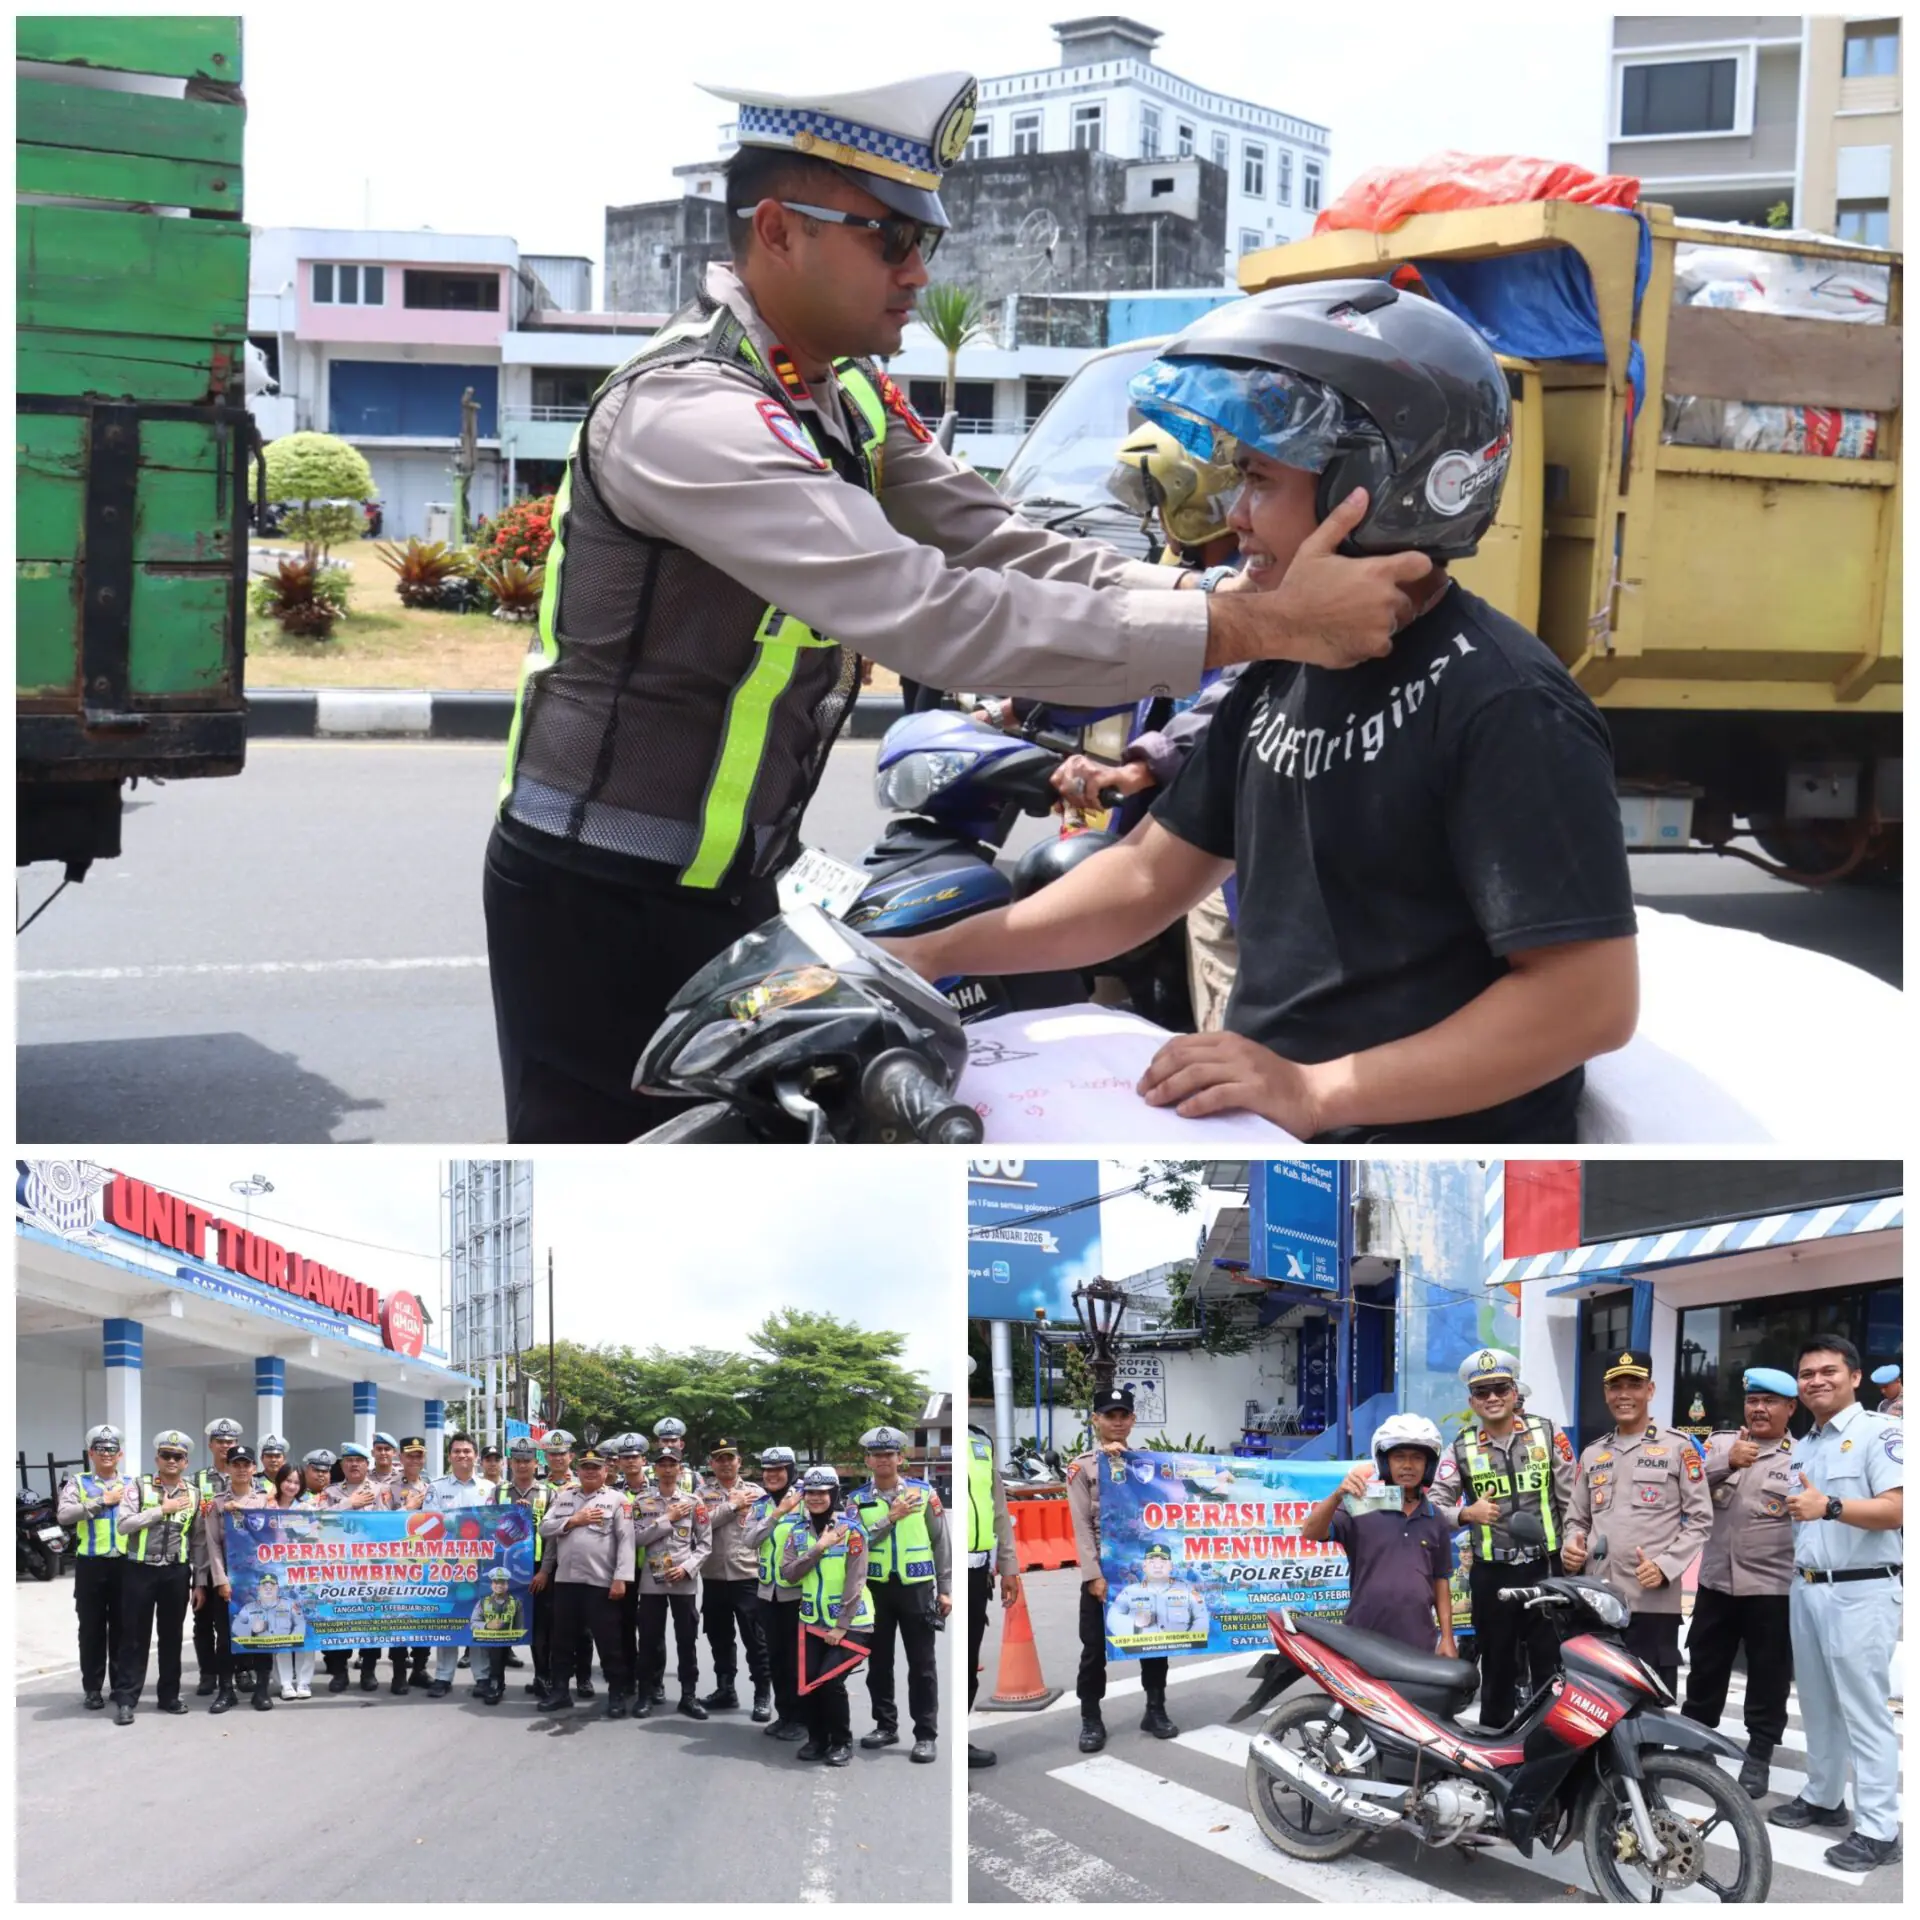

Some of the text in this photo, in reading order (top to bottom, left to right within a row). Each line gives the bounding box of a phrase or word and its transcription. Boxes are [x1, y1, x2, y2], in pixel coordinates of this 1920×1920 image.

[1311, 1163, 1332, 1179] Cepat
[1273, 1163, 1332, 1193] di Kab. Belitung
[983, 1199, 998, 1208] Fasa
[1000, 1202, 1023, 1210] semua
[991, 1230, 1023, 1240] JANUARI
[1023, 1232, 1044, 1243] 2026
[103, 1168, 381, 1326] UNIT TURJAWALI
[983, 1267, 990, 1276] di
[1315, 1273, 1335, 1284] more
[1118, 1367, 1160, 1376] KO-ZE
[1526, 1462, 1549, 1471] POLRI
[1637, 1458, 1669, 1469] POLRI
[1143, 1502, 1266, 1530] OPERASI
[257, 1540, 495, 1562] OPERASI KESELAMATAN
[286, 1564, 479, 1585] MENUMBING 2026
[1228, 1565, 1305, 1582] POLRES
[319, 1586, 448, 1599] POLRES BELITUNG
[1247, 1591, 1293, 1603] TANGGAL
[1294, 1591, 1306, 1602] 02
[1313, 1590, 1324, 1600] 15
[333, 1606, 364, 1614] TANGGAL
[389, 1604, 422, 1612] FEBRUARI
[1222, 1622, 1237, 1631] DAN
[322, 1634, 452, 1646] SATLANTAS POLRES BELITUNG
[1569, 1692, 1609, 1722] YAMAHA
